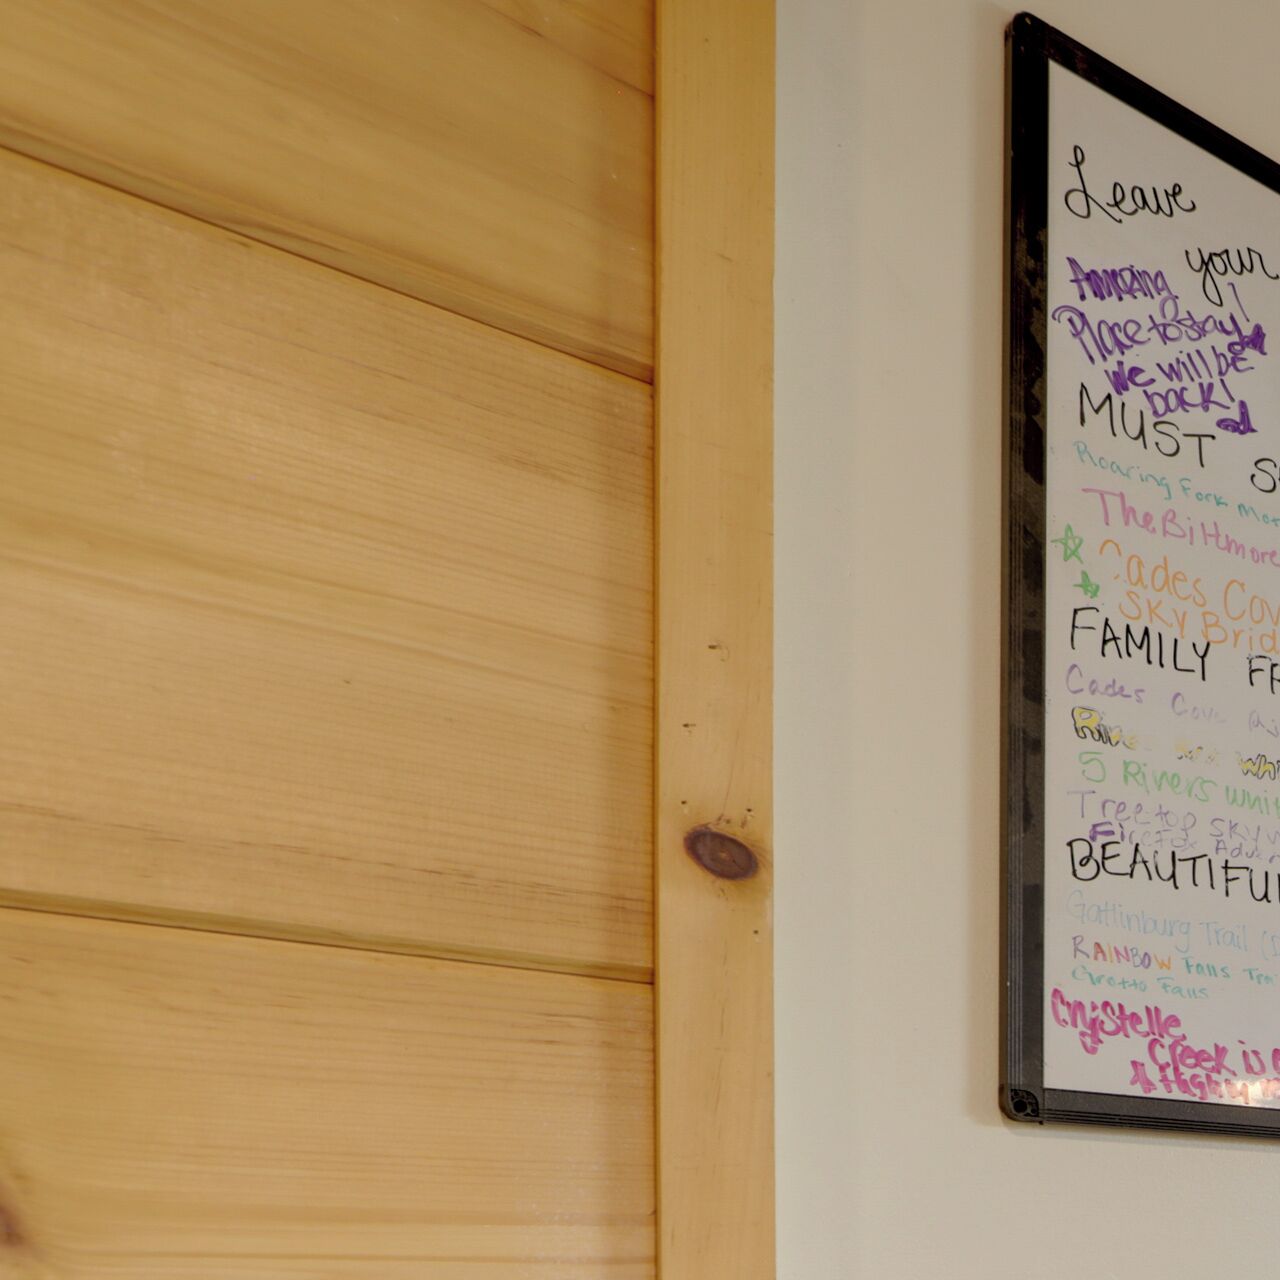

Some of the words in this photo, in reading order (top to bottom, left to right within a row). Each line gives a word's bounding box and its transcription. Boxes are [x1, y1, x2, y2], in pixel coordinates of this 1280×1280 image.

[1065, 145, 1196, 223] Leave
[1185, 246, 1280, 308] your
[1052, 305, 1150, 365] Place
[1157, 349, 1213, 382] will
[1080, 382, 1216, 468] MUST
[1142, 378, 1236, 419] back!
[1072, 440, 1173, 500] Roaring
[1081, 488, 1157, 535] The
[1099, 540, 1207, 607] ades
[1070, 606, 1211, 681] FAMILY
[1066, 664, 1145, 703] Cades
[1077, 751, 1106, 784] 5
[1122, 758, 1219, 805] Rivers
[1072, 935, 1172, 970] RAINBOW
[1200, 921, 1249, 951] Trail
